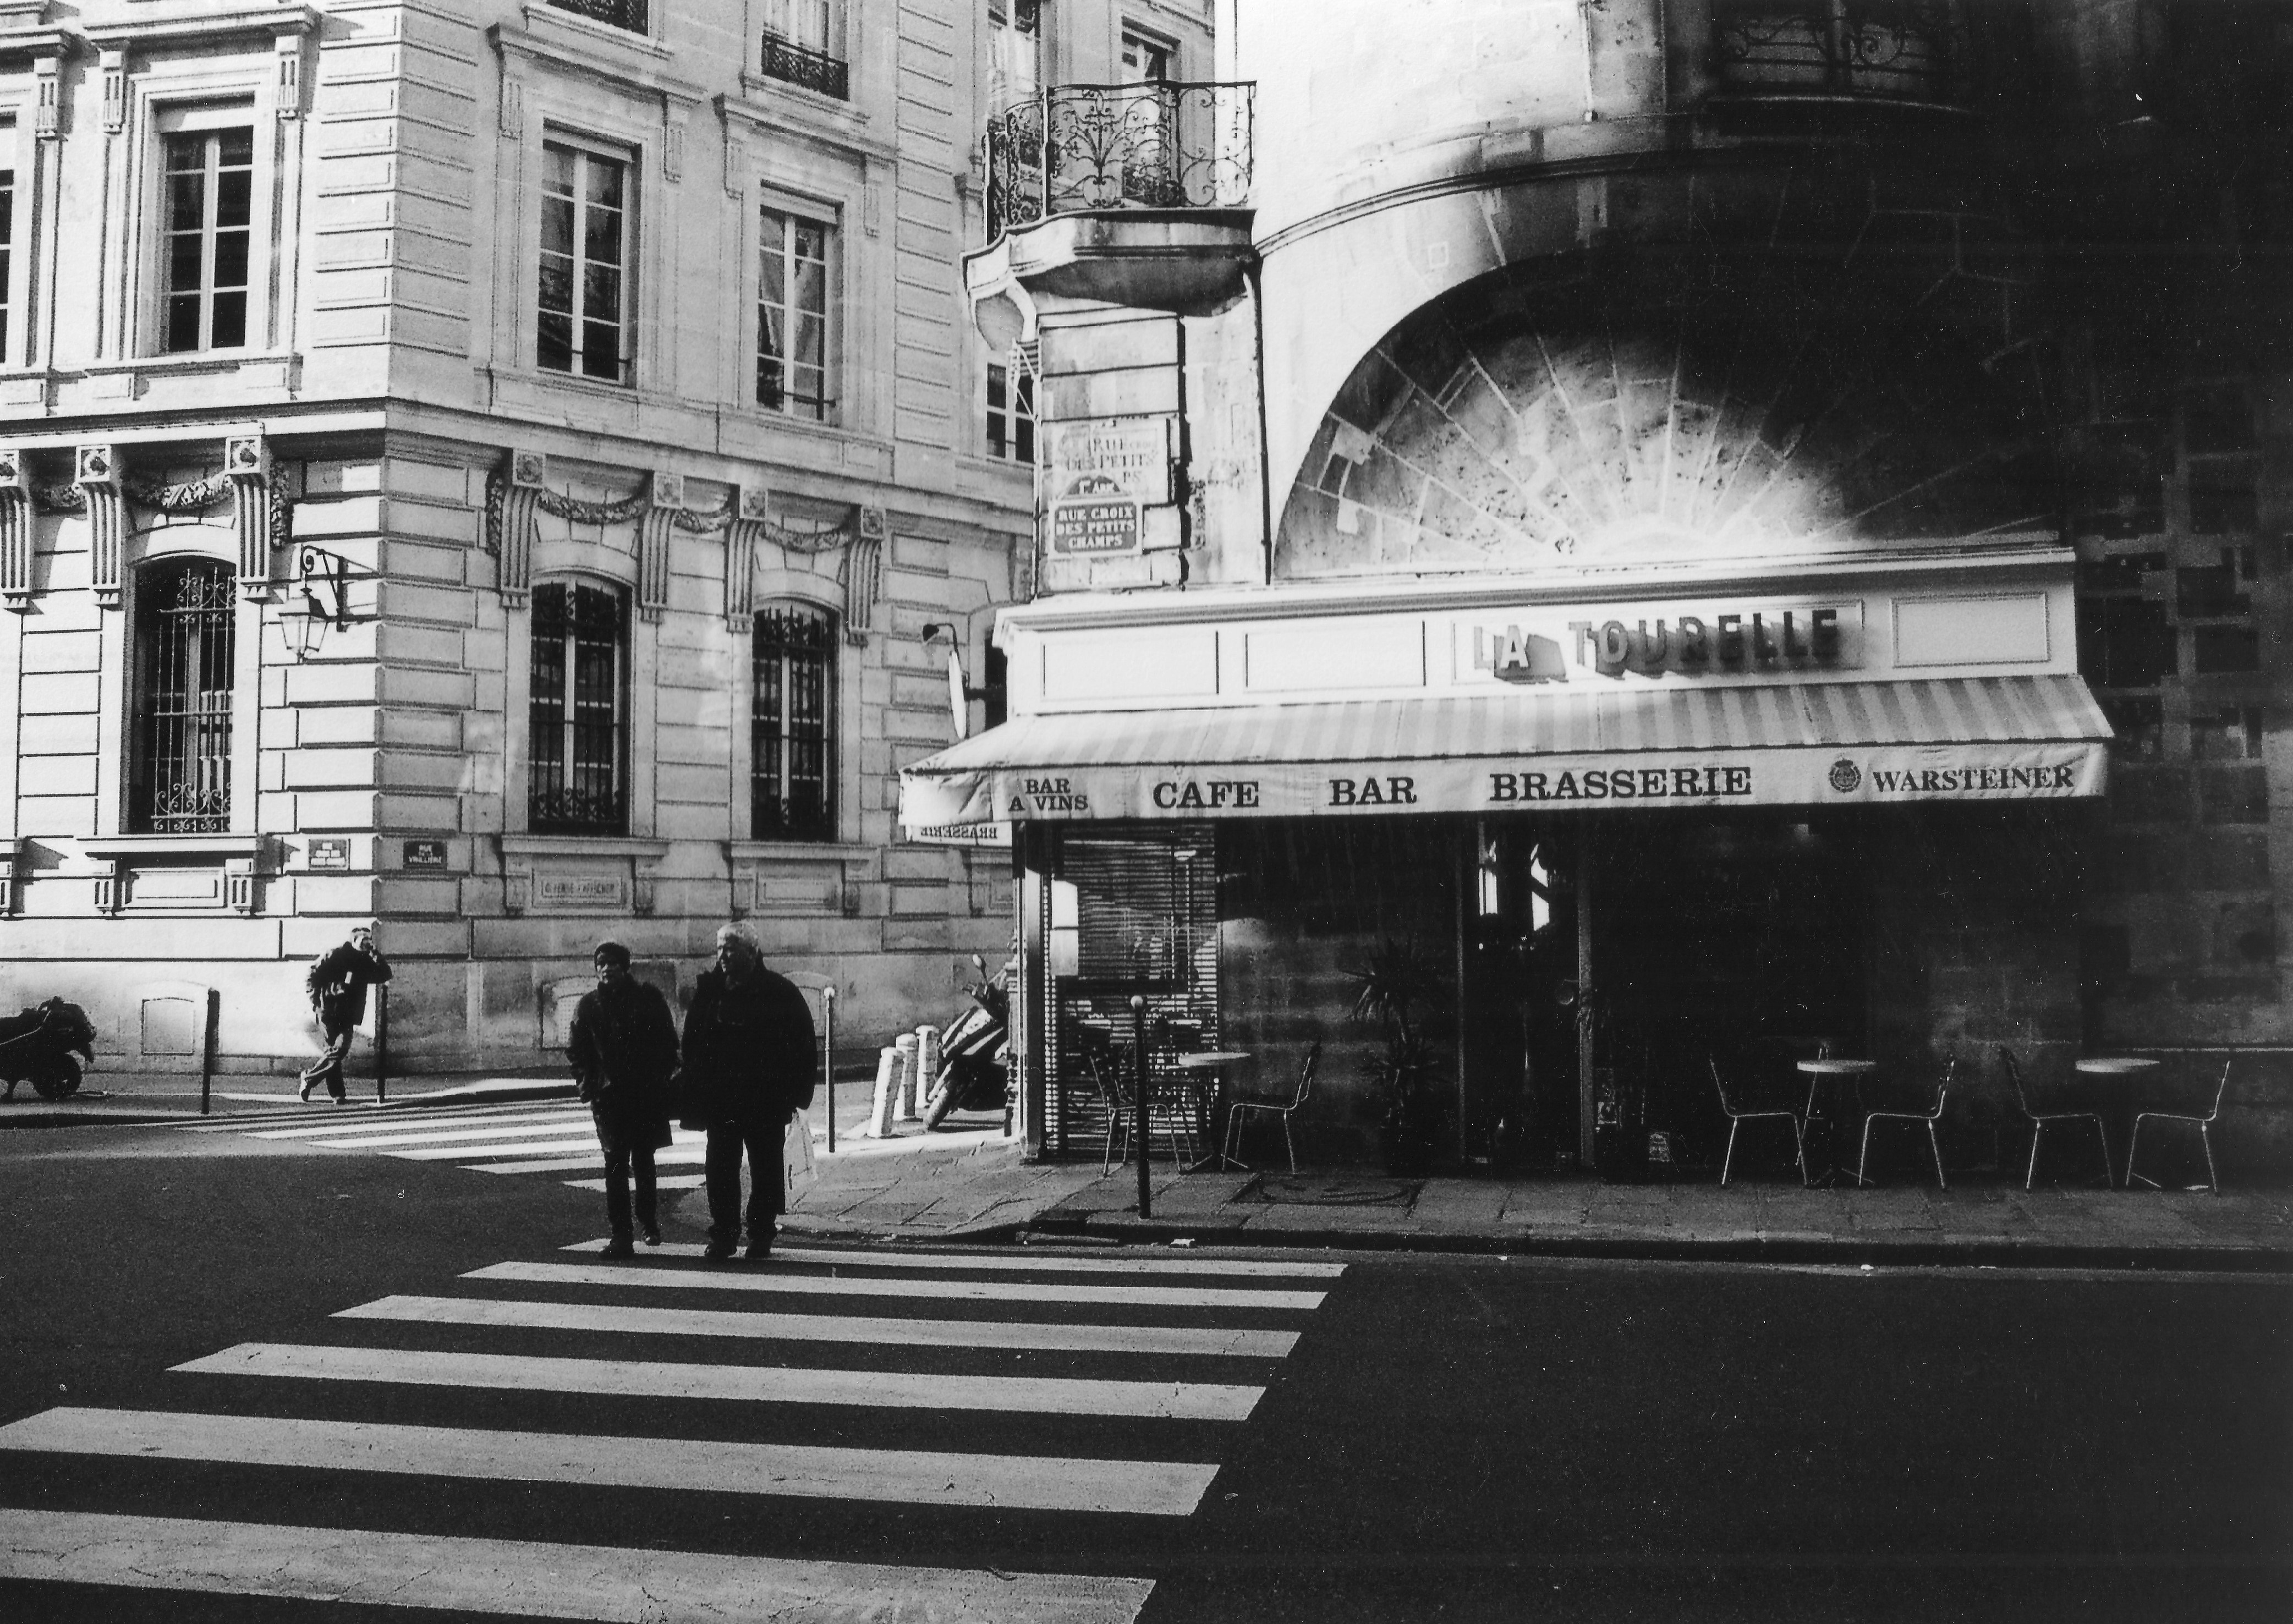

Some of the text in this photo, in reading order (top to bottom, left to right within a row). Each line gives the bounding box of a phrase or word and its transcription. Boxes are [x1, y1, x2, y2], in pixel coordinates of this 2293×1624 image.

[1058, 506, 1133, 522] RUE CROIX
[1056, 519, 1135, 535] DES PETITS
[1068, 534, 1123, 549] CHAMPS
[1474, 609, 1836, 670] LA TOURELLE
[1024, 777, 1071, 794] BAR
[1873, 766, 2074, 792] WARSTEINER
[1153, 766, 1752, 809] CAFE BAR BRASSERIE
[1008, 795, 1088, 811] A VINS
